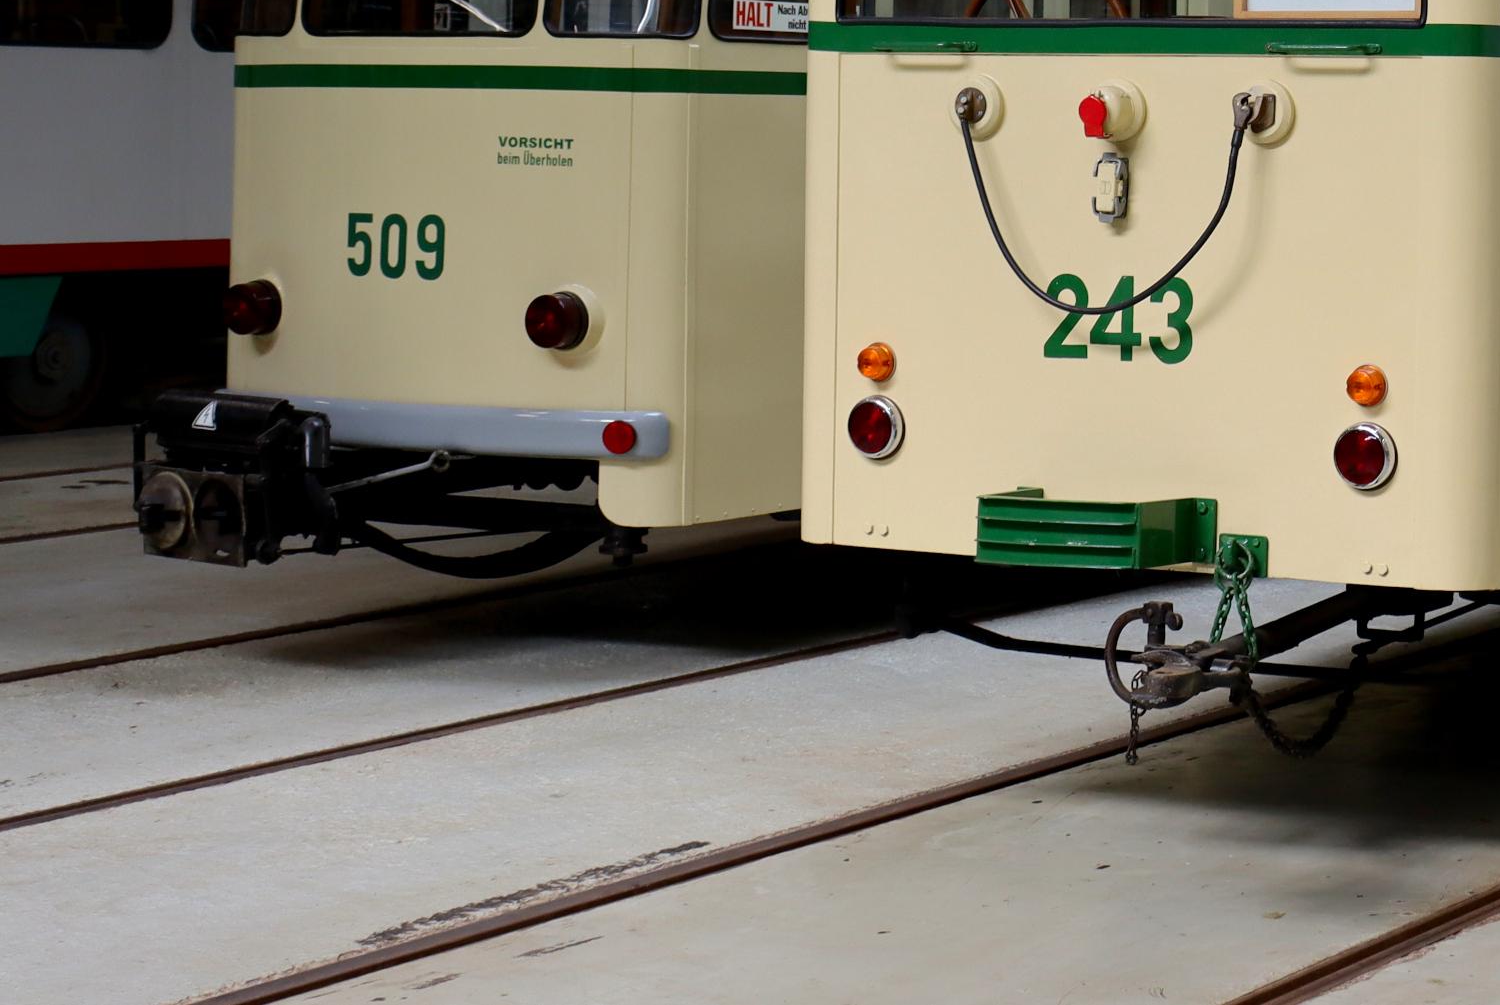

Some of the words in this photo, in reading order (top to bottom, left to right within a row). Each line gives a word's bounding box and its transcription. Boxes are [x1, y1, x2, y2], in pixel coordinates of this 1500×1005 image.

[736, 0, 774, 28] HALT
[778, 4, 796, 15] Nach
[788, 19, 807, 30] nicht
[498, 136, 574, 149] VORSICHT
[497, 152, 520, 164] beim
[523, 150, 573, 167] Überholen
[347, 213, 445, 281] 509
[1044, 273, 1194, 365] 243
